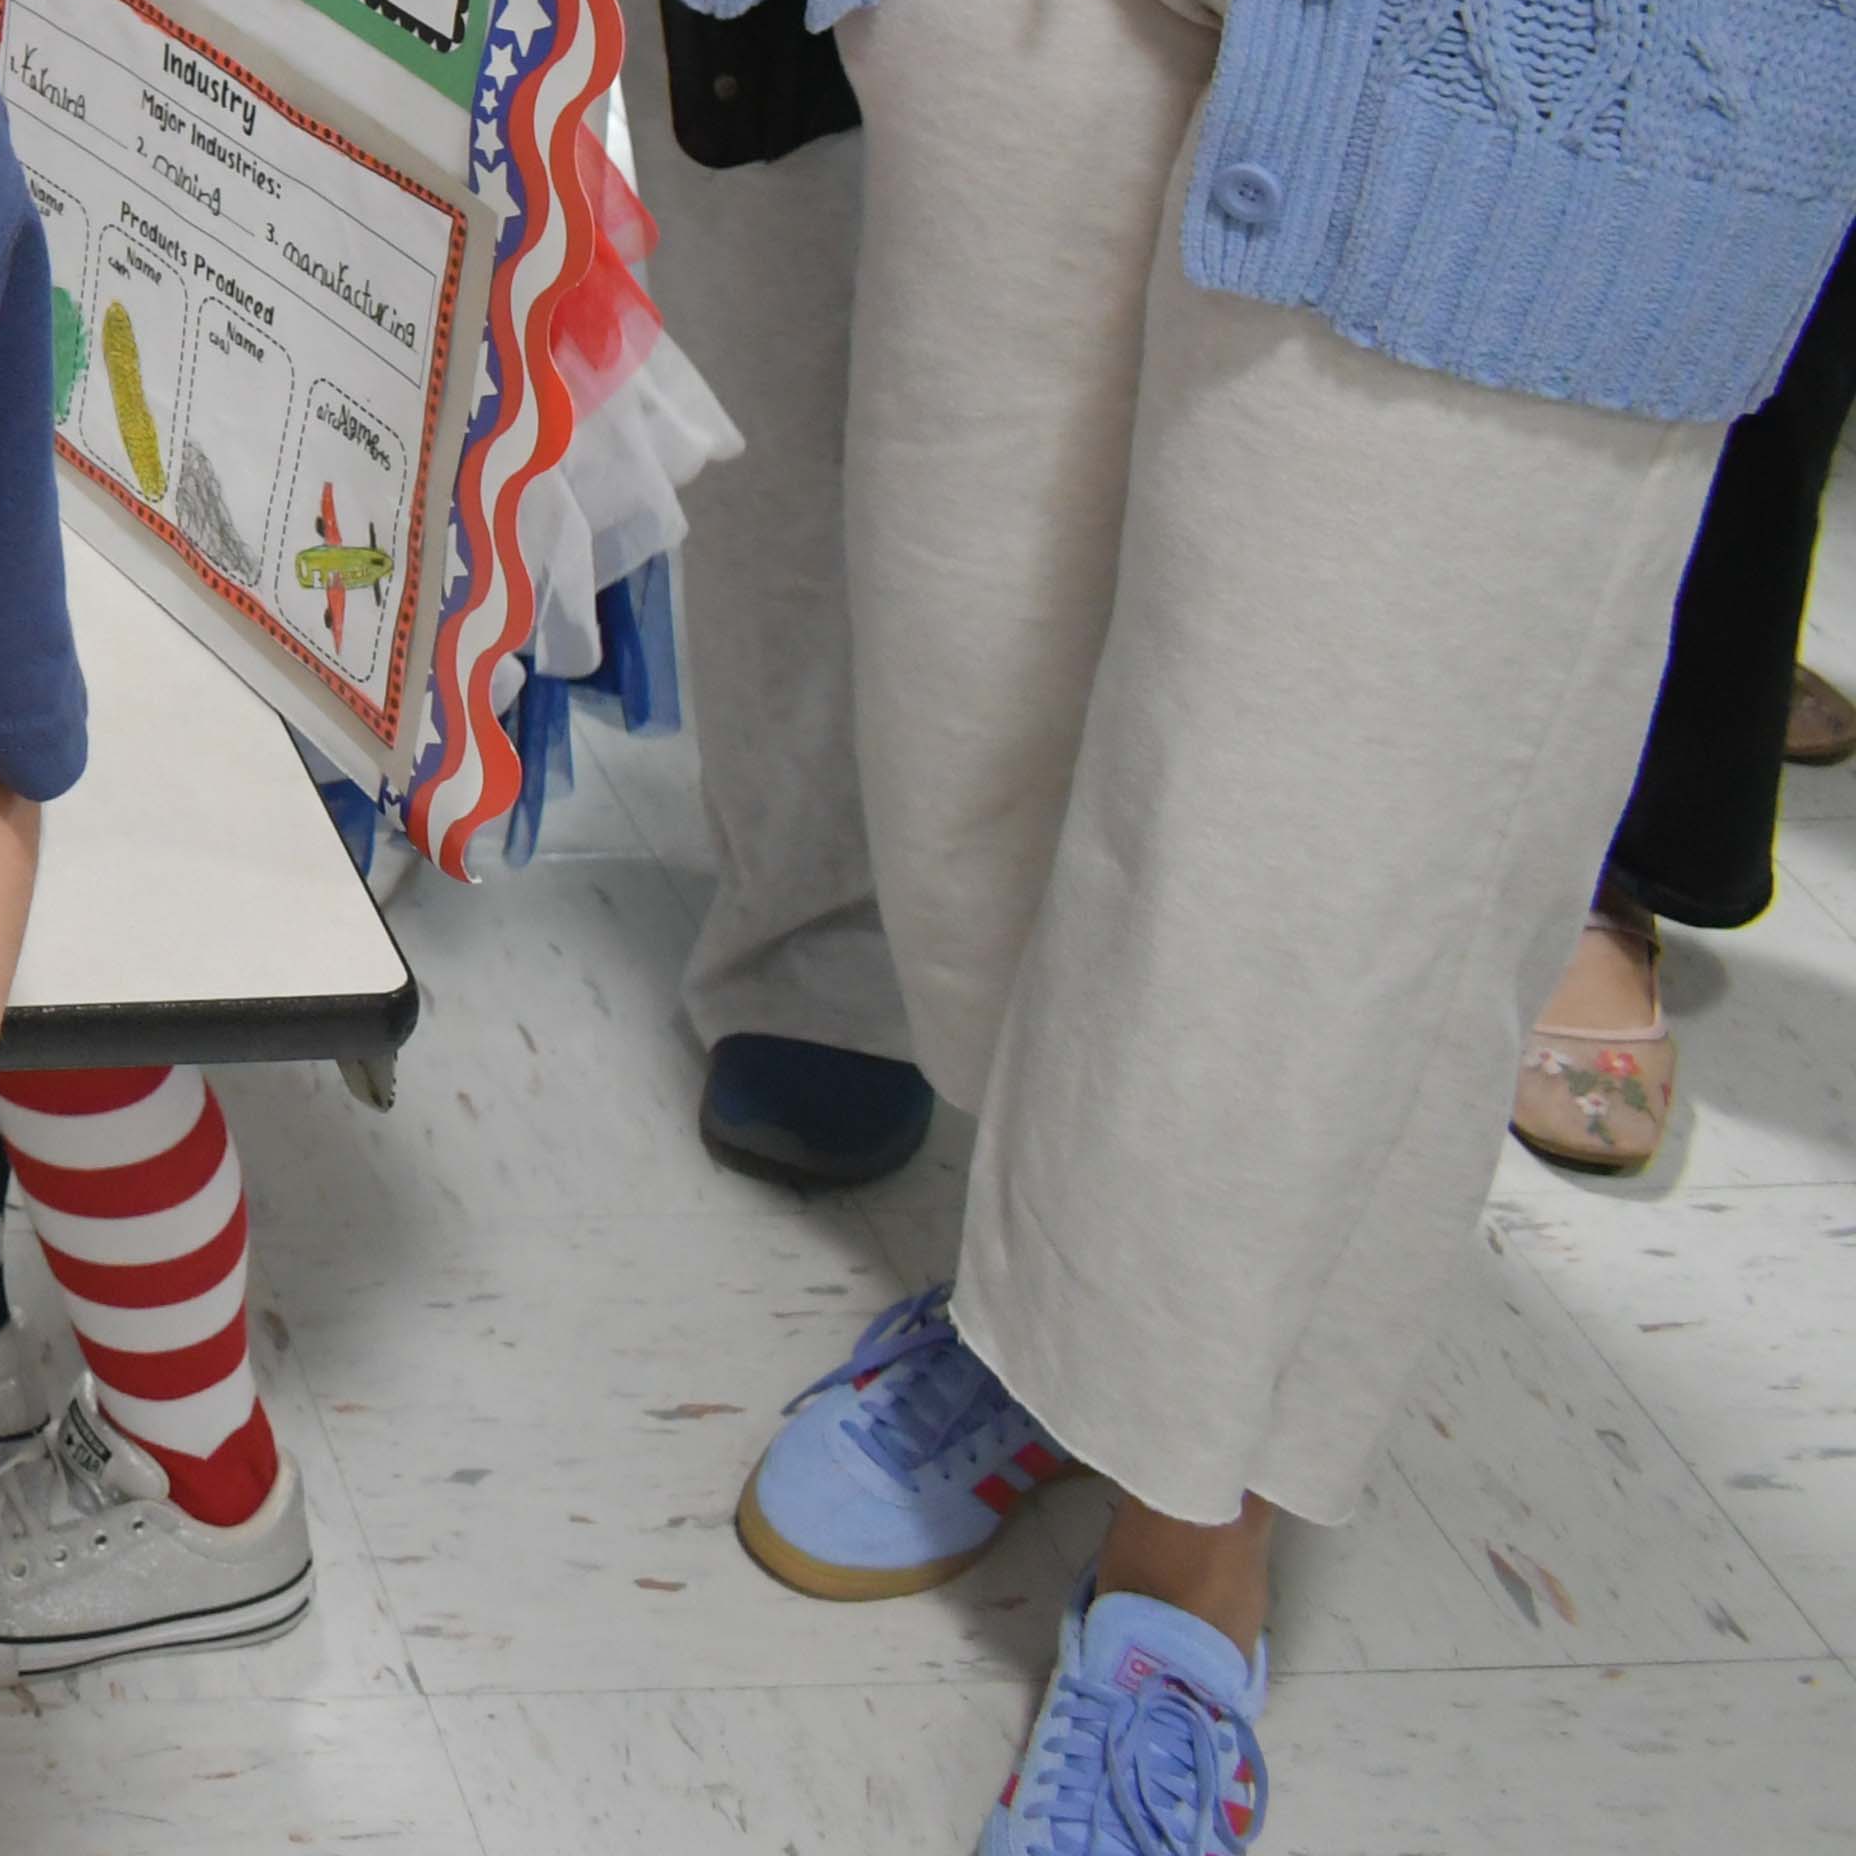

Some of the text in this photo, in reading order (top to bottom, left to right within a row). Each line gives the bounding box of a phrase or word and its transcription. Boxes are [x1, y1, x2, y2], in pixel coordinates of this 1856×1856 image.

[163, 42, 258, 137] Industry
[136, 136, 148, 159] 2.
[140, 89, 282, 200] Major Industries:
[29, 178, 65, 216] Name
[152, 153, 222, 217] mining
[264, 221, 280, 247] 3.
[119, 200, 274, 326] Products Produced
[126, 246, 163, 286] Name
[282, 240, 417, 348] manufacturing
[226, 320, 265, 363] Name
